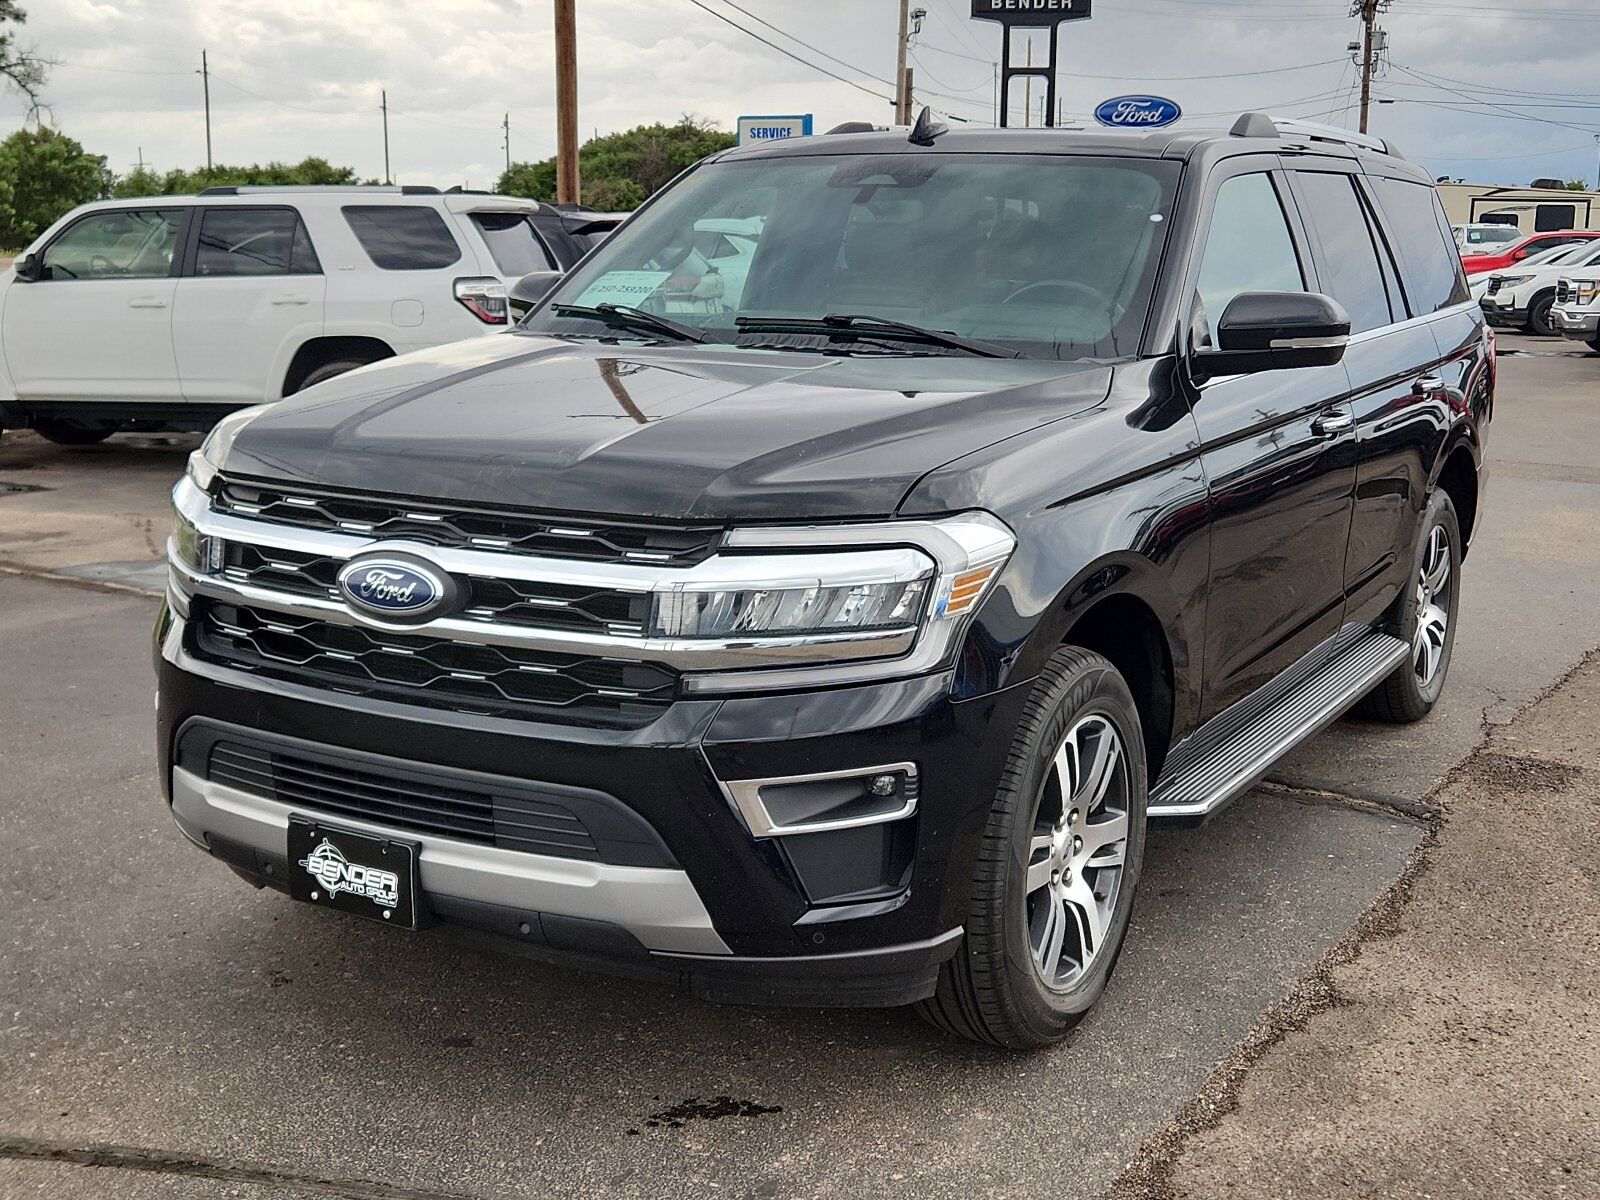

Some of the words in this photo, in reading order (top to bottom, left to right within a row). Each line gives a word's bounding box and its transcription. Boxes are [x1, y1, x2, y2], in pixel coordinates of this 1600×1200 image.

[991, 0, 1072, 9] BENDER
[1112, 101, 1165, 123] Ford
[750, 127, 792, 139] SERVICE
[361, 569, 417, 603] Ford
[308, 856, 396, 892] BENDER
[340, 880, 365, 894] AUTO
[366, 886, 397, 900] GROUP
